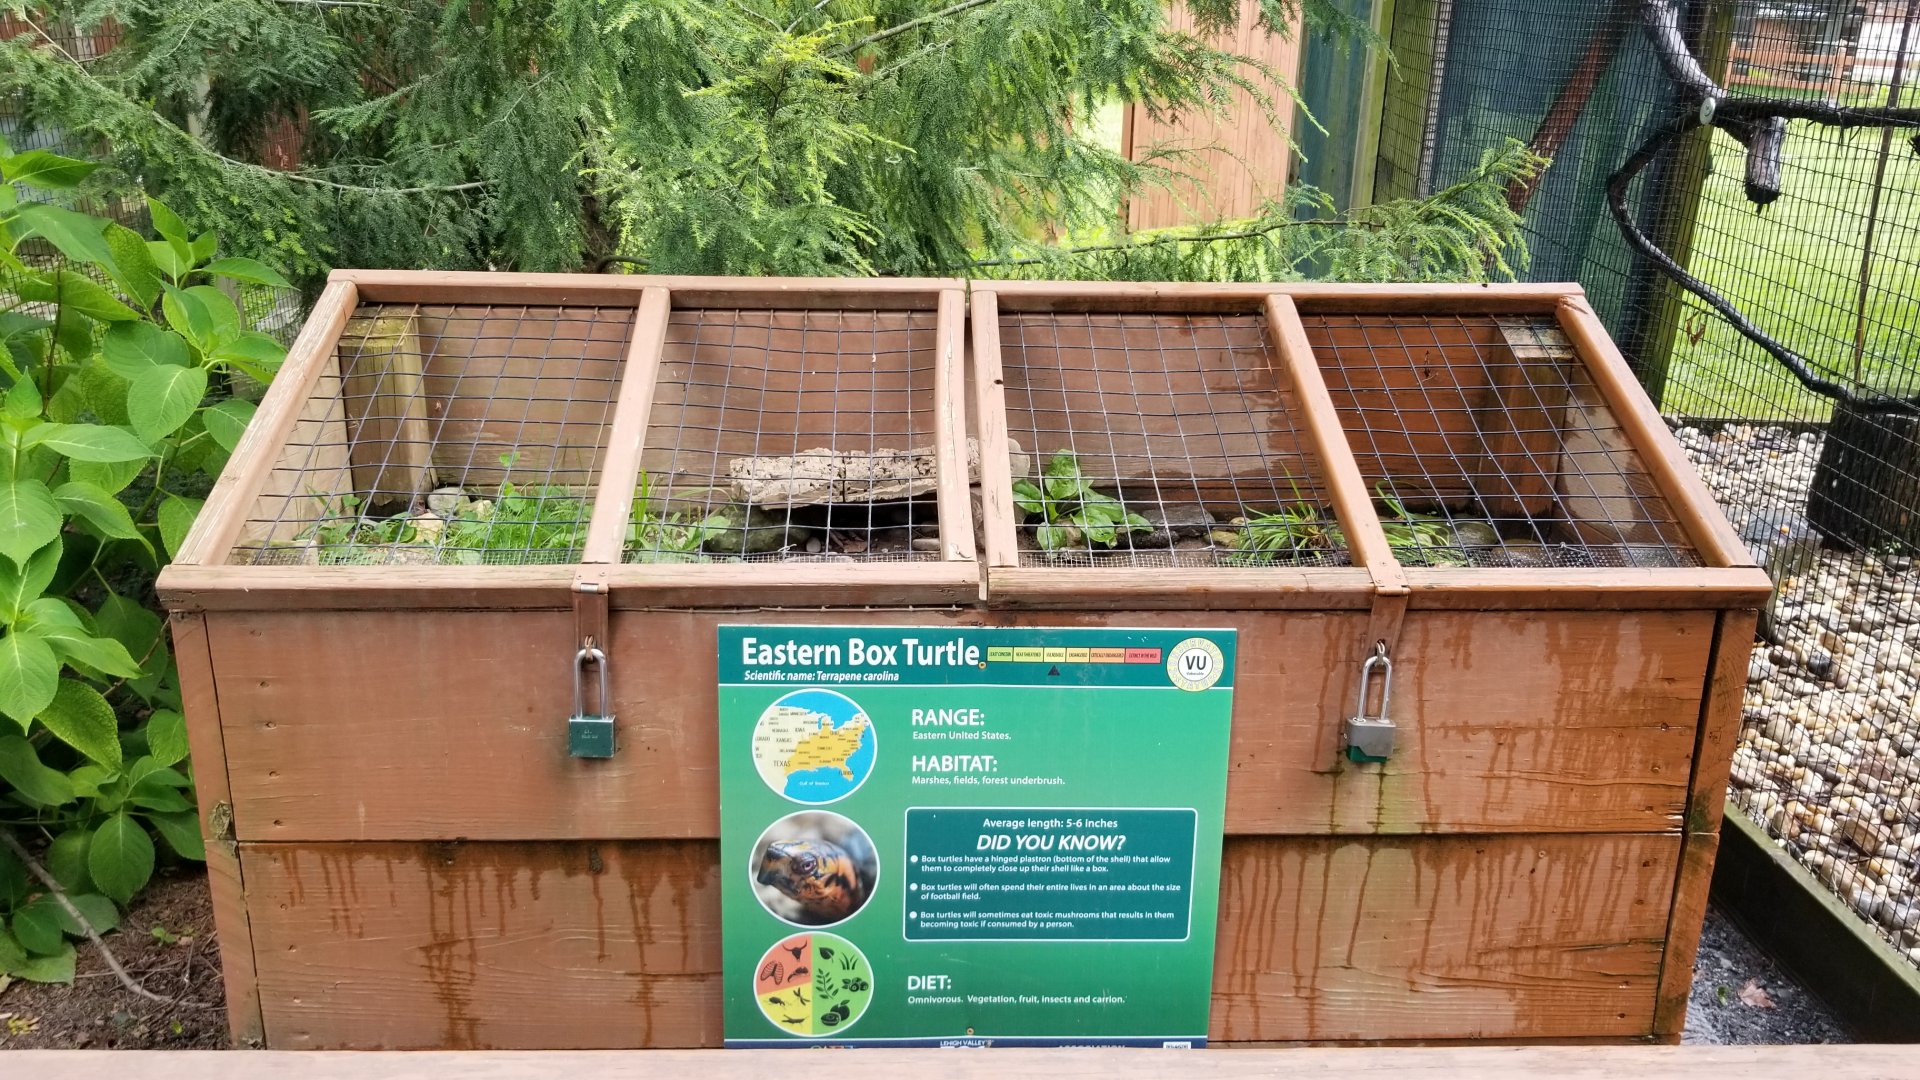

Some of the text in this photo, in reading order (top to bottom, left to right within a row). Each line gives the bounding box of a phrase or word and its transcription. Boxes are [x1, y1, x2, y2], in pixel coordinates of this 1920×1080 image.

[743, 637, 979, 666] Eastern Box Turtle
[1185, 655, 1207, 671] VU
[744, 670, 899, 683] Scientific name: Terrapene carolina
[912, 709, 984, 725] RANGE:
[913, 731, 1011, 740] Eastern United States.
[913, 755, 997, 771] HABITAT:
[912, 776, 1065, 785] Marshes, fields, forest underbrush.
[983, 818, 1118, 830] Average length: 5-6 inches
[977, 835, 1126, 850] DID YOU KNOW?
[921, 855, 936, 863] Box
[964, 855, 983, 863] have
[990, 855, 1018, 865] hinged
[1020, 855, 1051, 865] plastron
[1053, 855, 1085, 865] (bottom
[1096, 855, 1109, 863] the
[953, 865, 996, 873] completely
[921, 883, 935, 891] Box
[937, 883, 962, 891] turtles
[964, 883, 978, 891] will
[979, 883, 999, 891] often
[1001, 883, 1025, 892] spend
[1070, 883, 1087, 891] lives
[962, 892, 980, 900] field.
[978, 911, 1019, 919] sometimes
[1021, 911, 1033, 919] eat
[920, 921, 959, 929] becoming
[1046, 922, 1075, 930] person.
[908, 975, 951, 990] DIET:
[908, 996, 963, 1004] Omnivorous.
[967, 995, 1017, 1004] Vegetation,
[1019, 995, 1039, 1003] fruit,
[1041, 995, 1071, 1003] insects
[1073, 995, 1090, 1003] and
